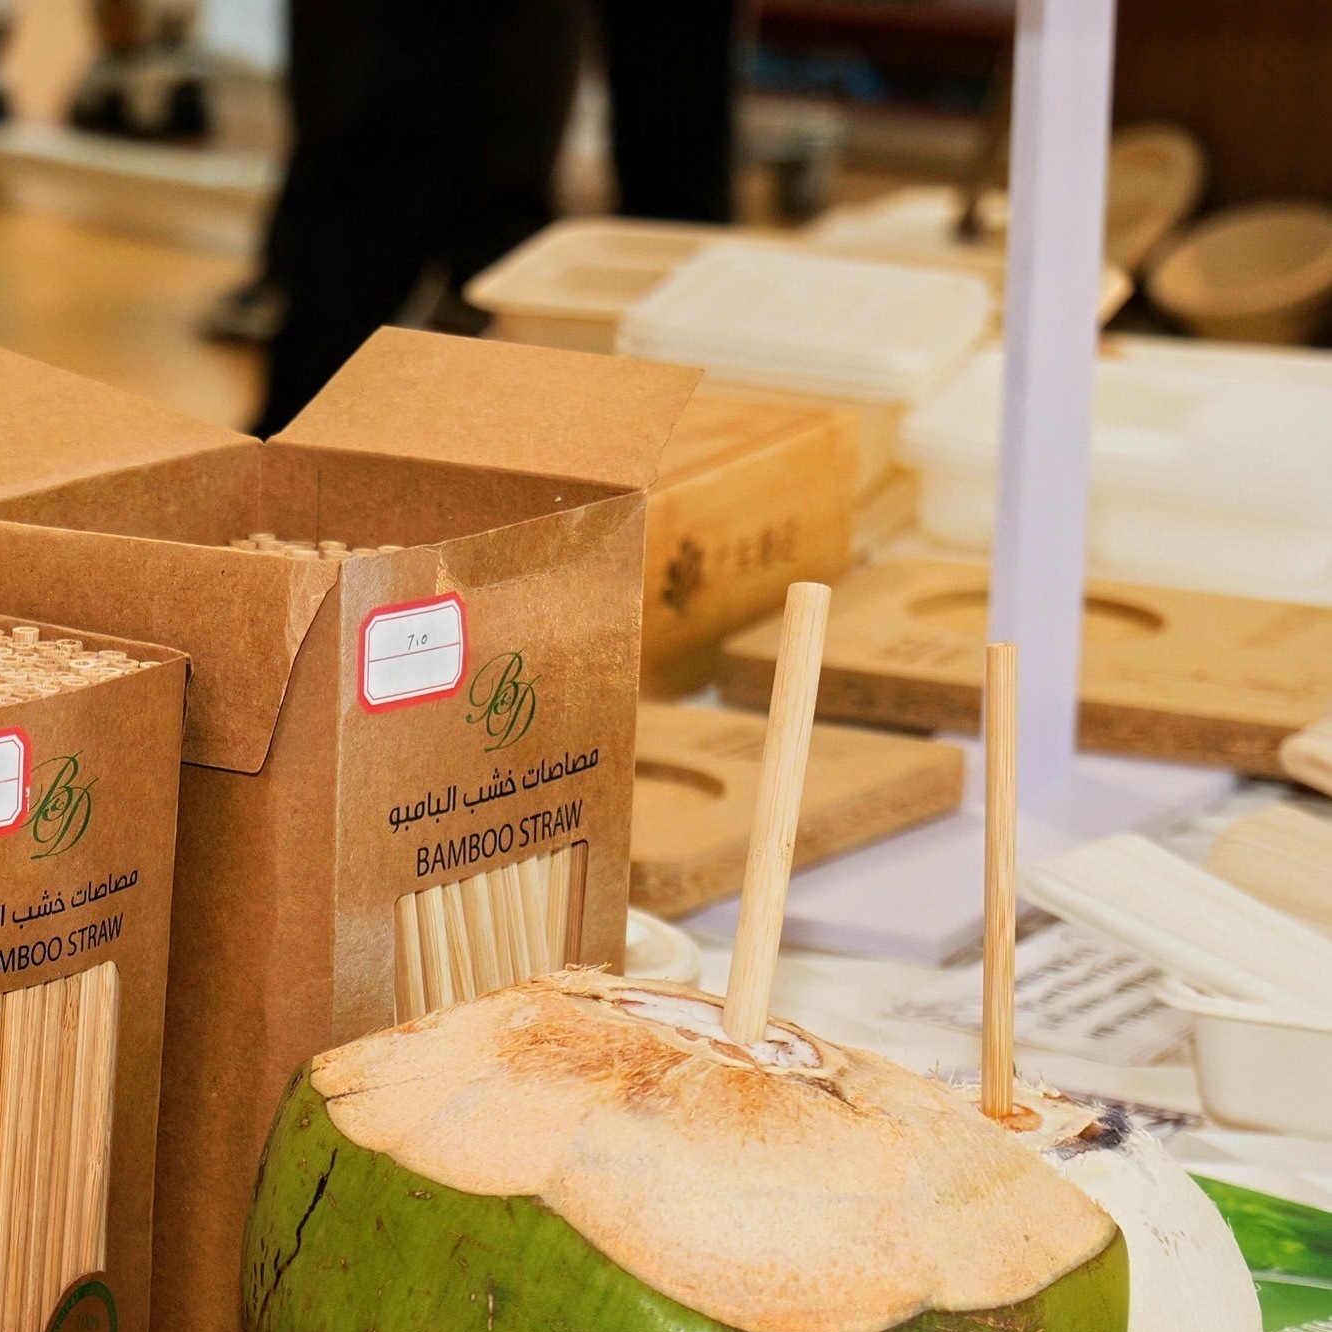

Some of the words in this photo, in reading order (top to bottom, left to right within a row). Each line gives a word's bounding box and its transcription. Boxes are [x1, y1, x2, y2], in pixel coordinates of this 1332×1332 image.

[463, 768, 517, 815] خشب
[522, 748, 599, 790] مصاصات
[389, 785, 457, 834] البامبو
[416, 823, 514, 878] BAMBOO
[519, 799, 583, 848] STRAW
[11, 890, 66, 929] خشب
[71, 870, 139, 908] مصاصات
[67, 912, 124, 957] STRAW
